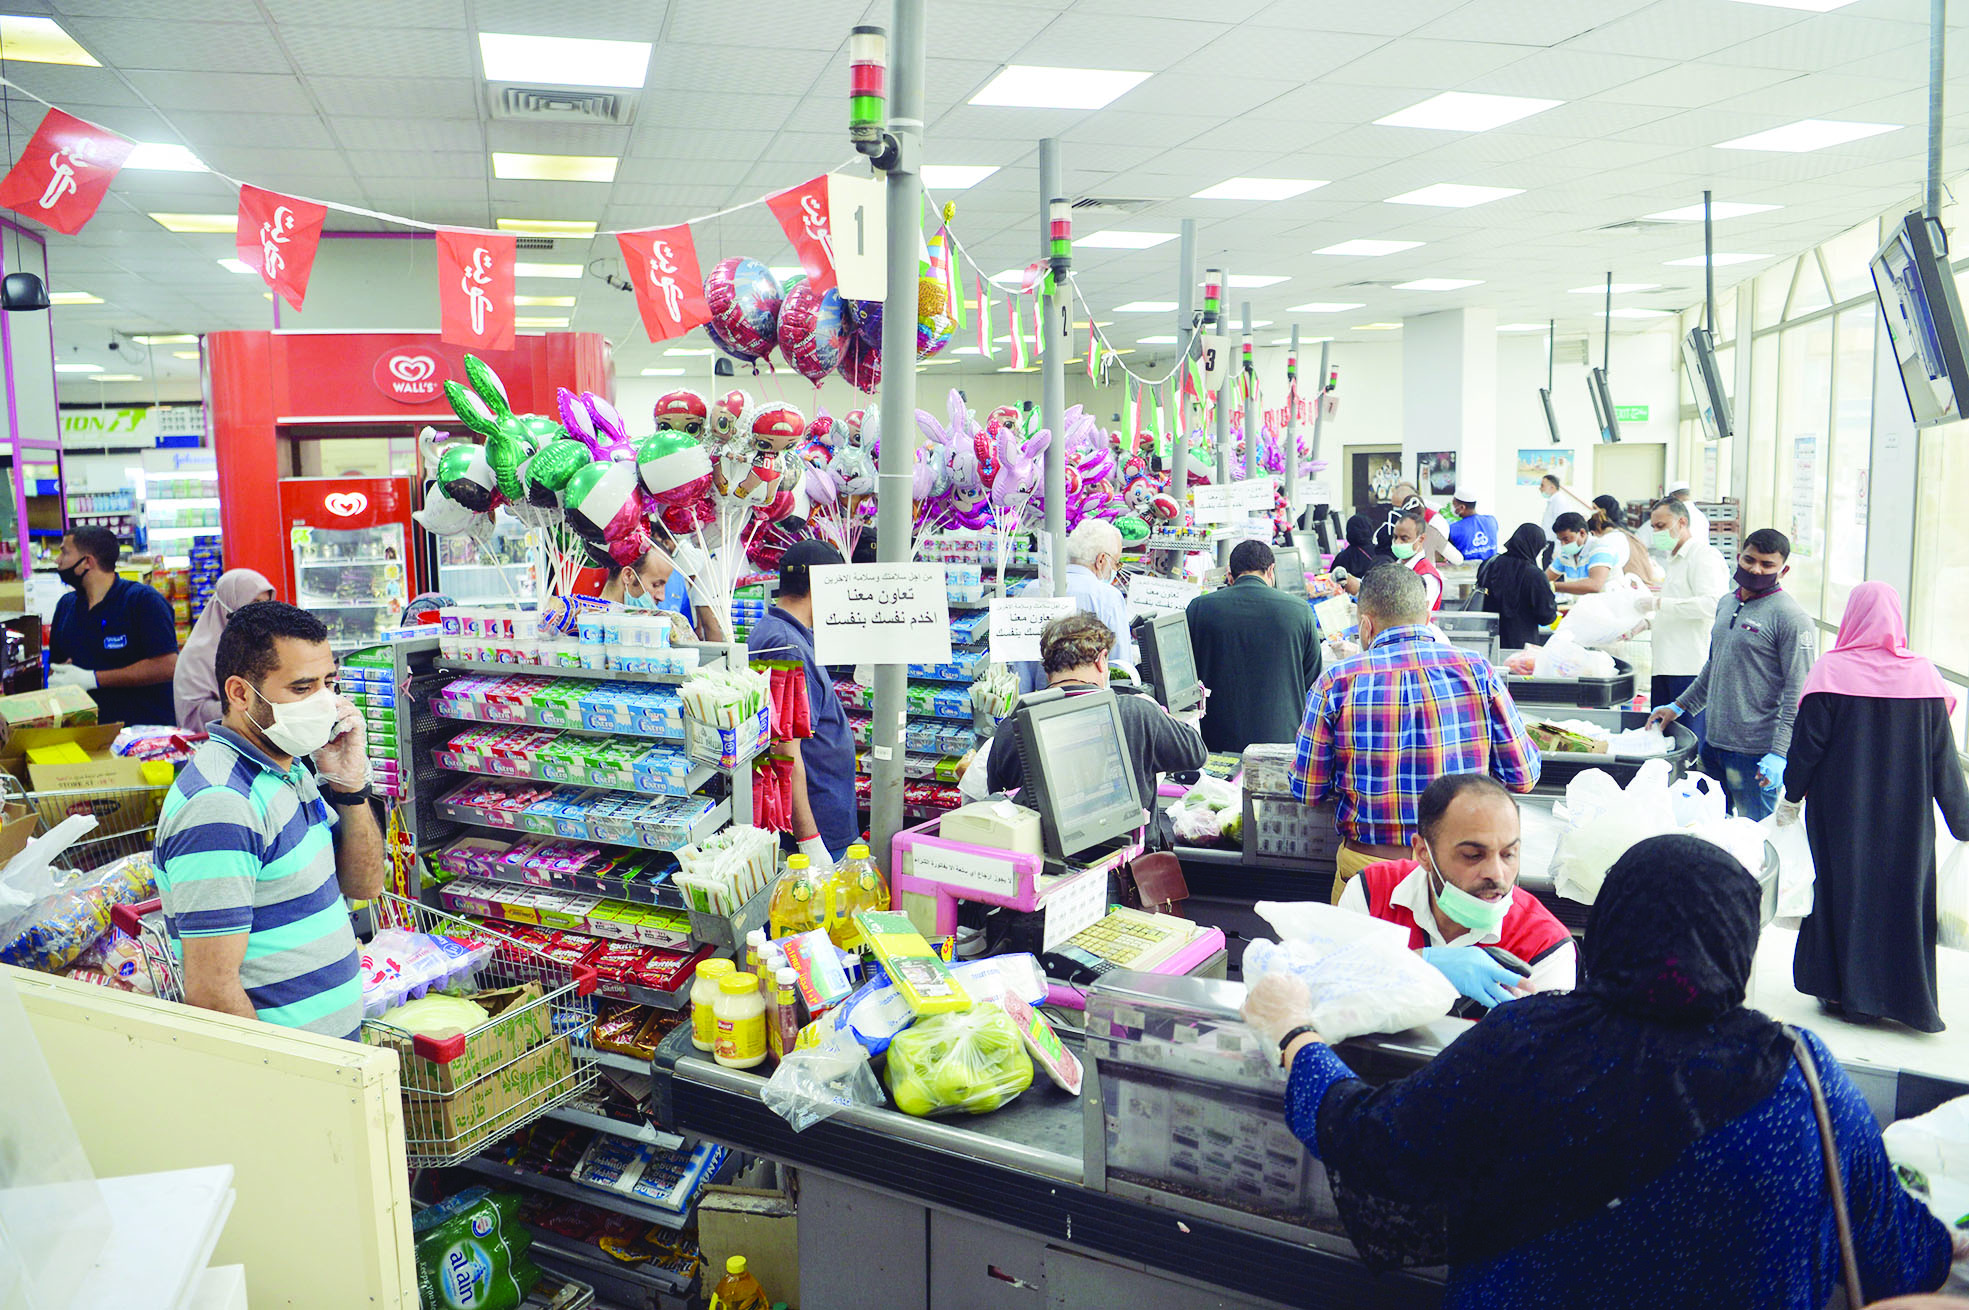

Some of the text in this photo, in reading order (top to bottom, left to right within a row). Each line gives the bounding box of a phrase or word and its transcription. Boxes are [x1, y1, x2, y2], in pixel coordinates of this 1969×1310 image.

[854, 205, 864, 256] 1
[461, 248, 494, 336] كويت
[1062, 305, 1068, 336] 2
[1205, 349, 1216, 371] 3
[393, 382, 434, 393] WALL'S
[60, 416, 104, 432] ION
[848, 587, 914, 604] تعاون معنا
[825, 610, 937, 630] اخدم نفسك بنفسك
[602, 984, 626, 992] Skittles
